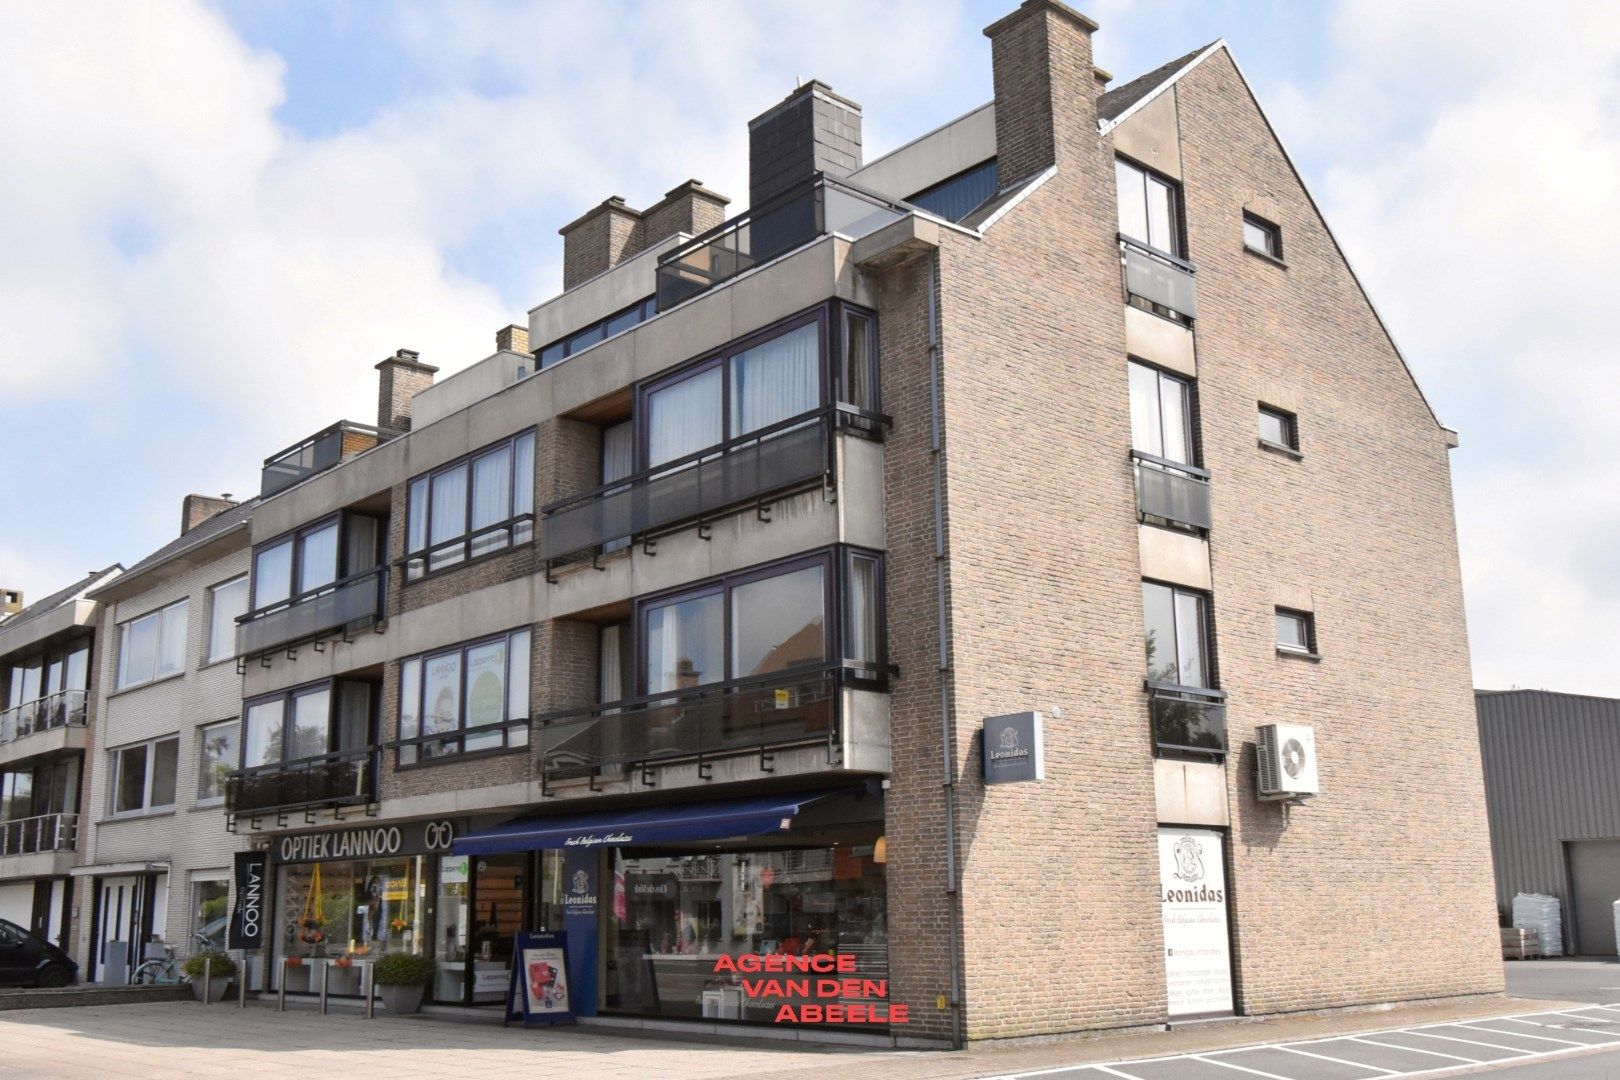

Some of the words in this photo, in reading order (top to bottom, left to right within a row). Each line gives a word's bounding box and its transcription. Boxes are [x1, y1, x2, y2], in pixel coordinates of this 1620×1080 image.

[990, 747, 1029, 760] Leonidas
[281, 833, 330, 861] OPTIEK
[333, 827, 401, 857] LANNOO
[564, 835, 581, 846] Fresh
[580, 834, 602, 848] Belgian
[602, 832, 633, 843] Chocolates
[245, 863, 262, 937] LANNOO
[565, 893, 597, 905] Leonidas
[1160, 884, 1223, 903] Leonidas
